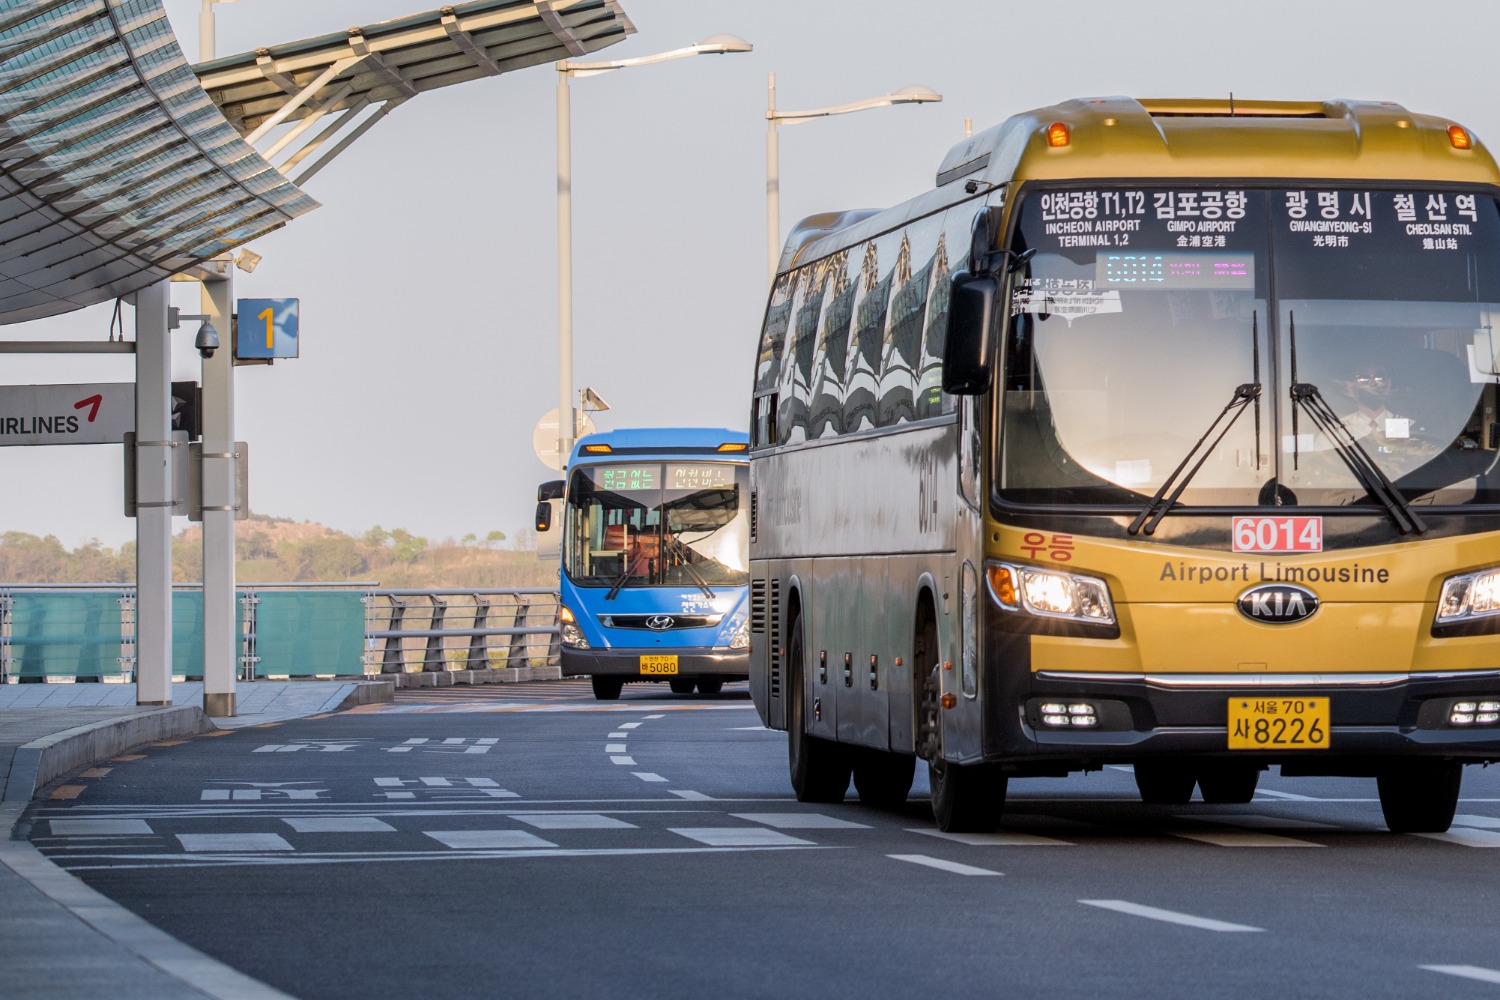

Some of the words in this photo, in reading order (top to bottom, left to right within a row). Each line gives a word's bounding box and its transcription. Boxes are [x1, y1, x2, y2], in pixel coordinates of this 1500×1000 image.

[1041, 191, 1098, 221] 인천공항
[1101, 190, 1145, 218] T1,T2
[1153, 190, 1248, 220] 김포공항
[1045, 221, 1092, 235] INCHEON
[1095, 219, 1141, 232] AIRPORT
[1167, 221, 1196, 233] GIMPO
[1197, 220, 1236, 233] AIRPORT
[1289, 221, 1372, 234] GWANGMYEONG-SI
[1406, 224, 1451, 236] CHEOLSAN
[1452, 225, 1472, 236] STN.
[1058, 234, 1111, 248] TERMINAL
[1313, 235, 1349, 247] 光明市
[257, 307, 274, 349] 1
[1233, 518, 1321, 550] 6014
[1020, 533, 1075, 562] 우등
[1159, 561, 1249, 584] Airport
[1259, 562, 1390, 583] Limousine
[1251, 592, 1308, 616] KIA
[1254, 700, 1278, 714] 서울
[1282, 700, 1304, 714] 70
